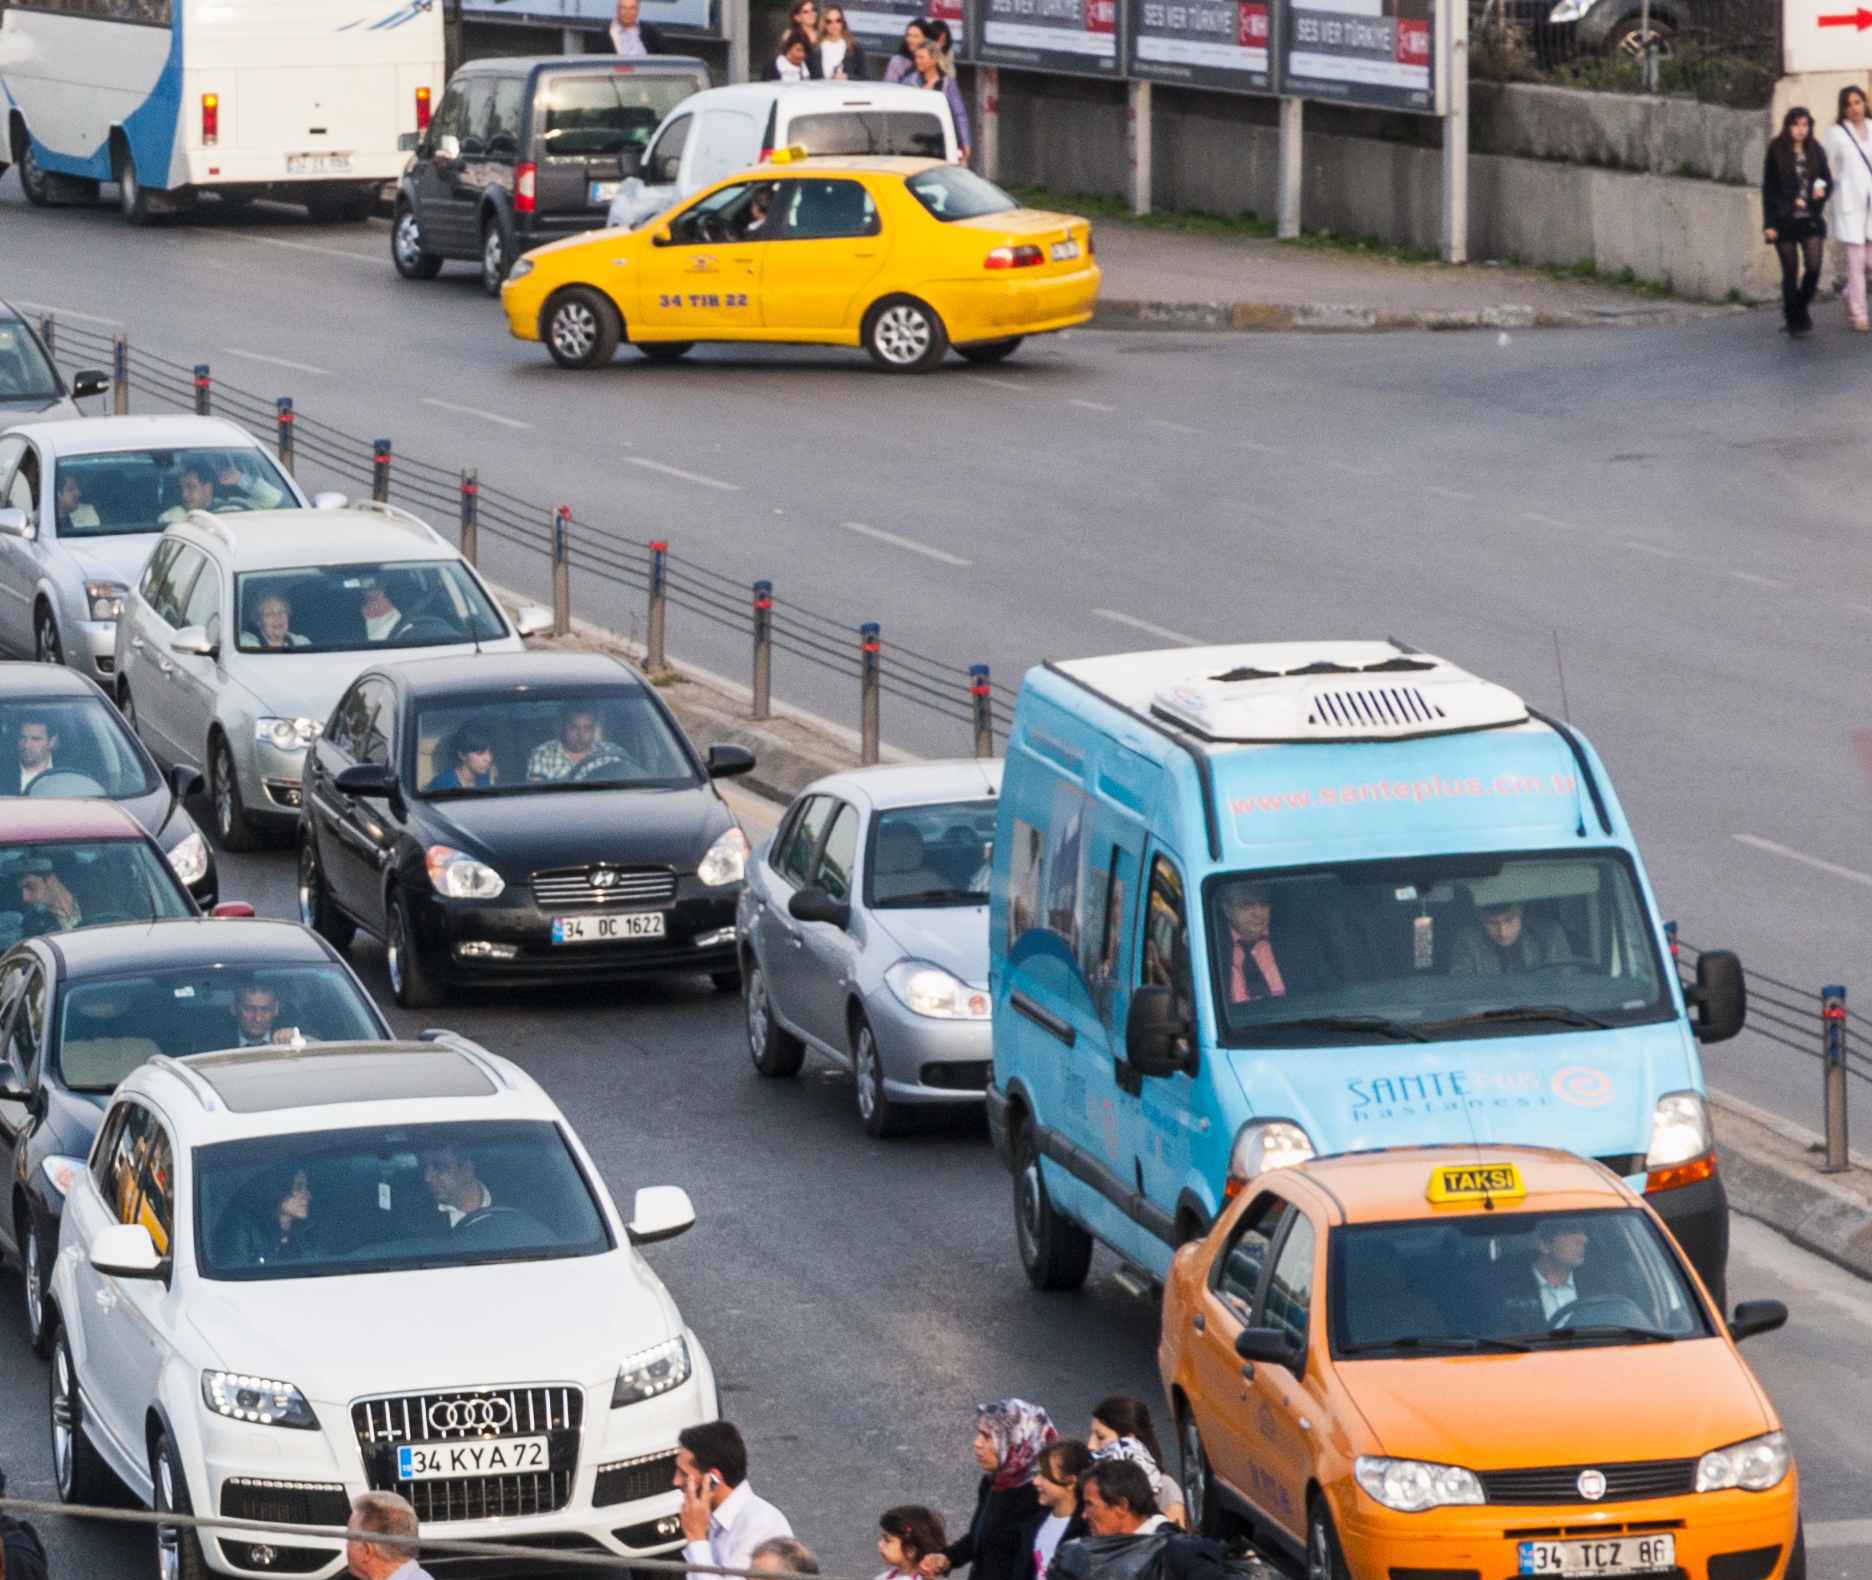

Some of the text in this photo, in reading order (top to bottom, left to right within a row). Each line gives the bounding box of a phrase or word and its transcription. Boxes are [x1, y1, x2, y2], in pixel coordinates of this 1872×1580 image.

[566, 922, 584, 938] 34
[627, 915, 661, 935] 1622
[413, 1442, 544, 1475] 34 KYA 72
[1536, 1547, 1562, 1571] 34
[1580, 1543, 1623, 1569] TCZ
